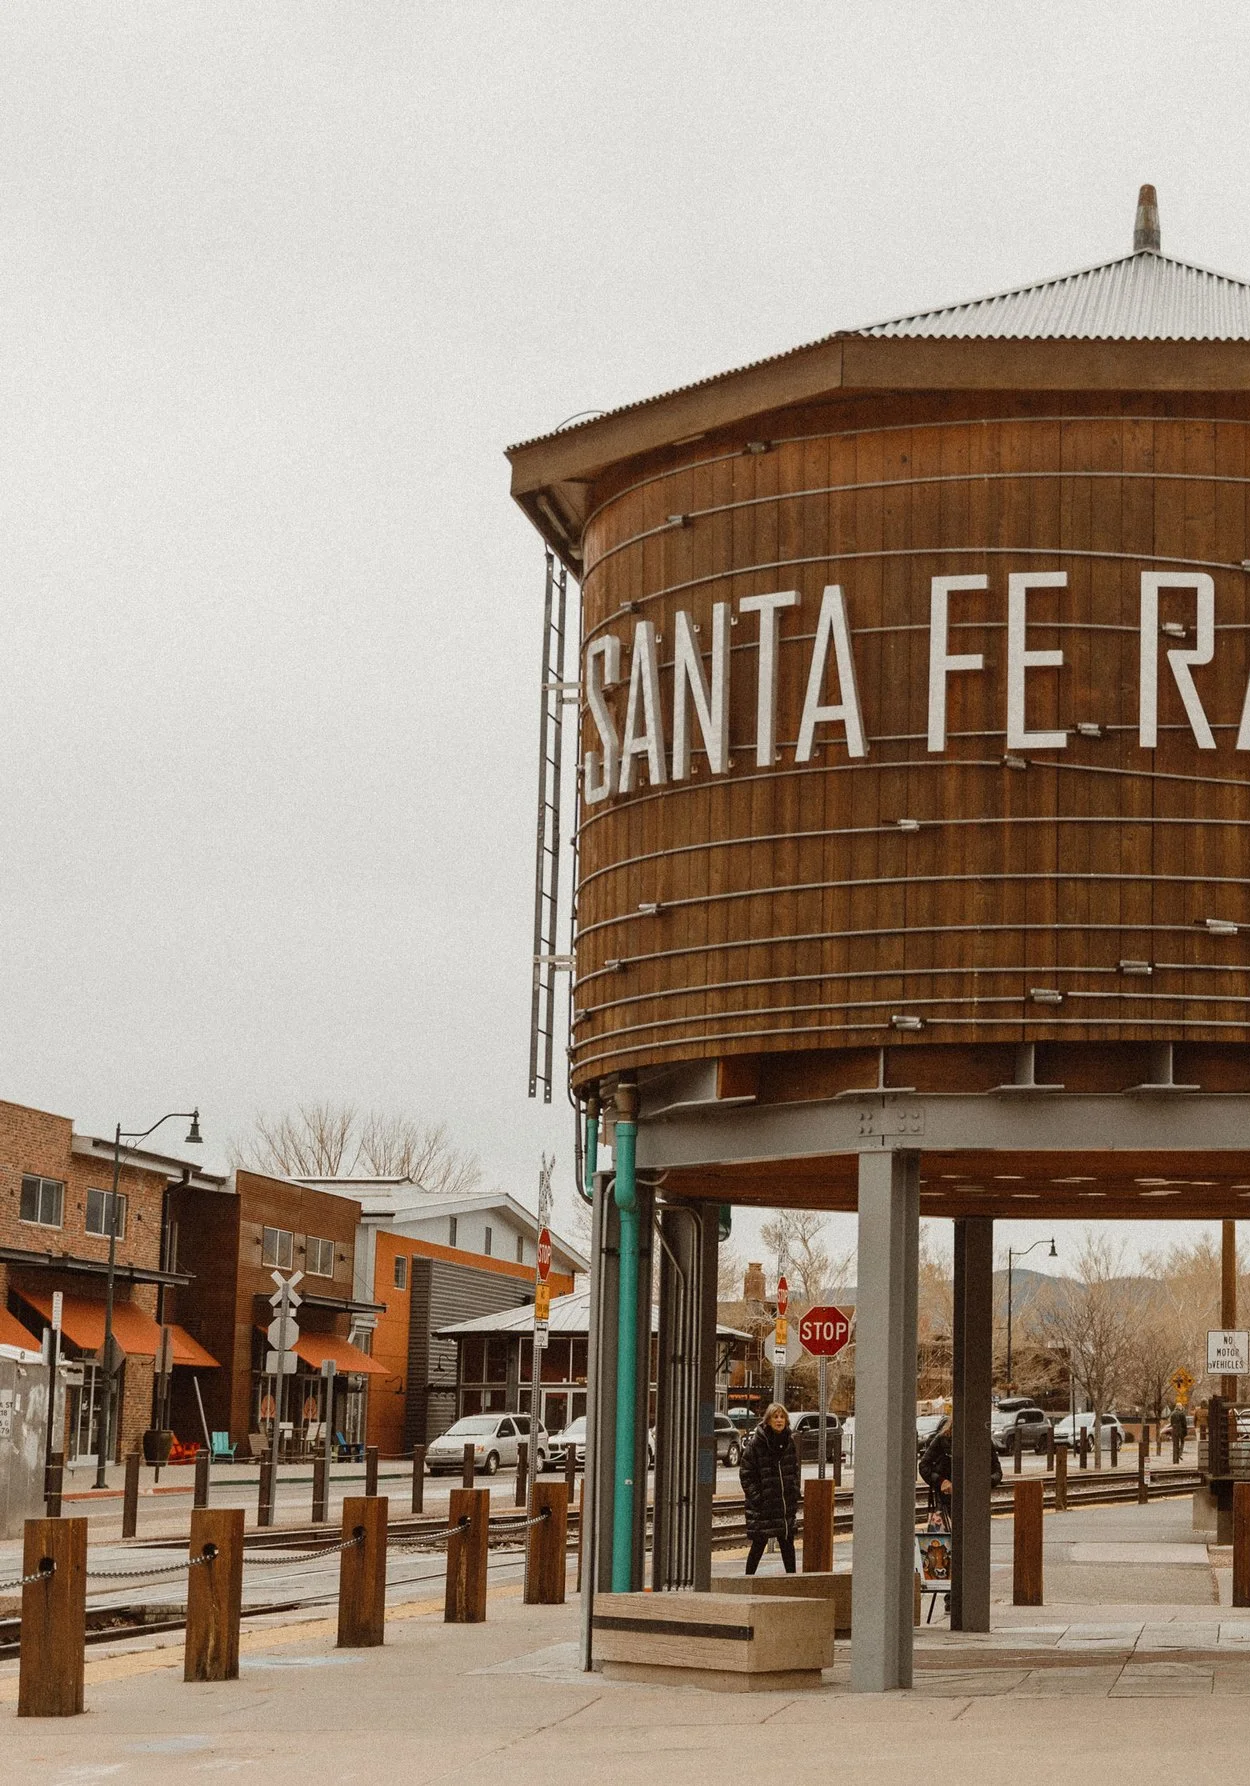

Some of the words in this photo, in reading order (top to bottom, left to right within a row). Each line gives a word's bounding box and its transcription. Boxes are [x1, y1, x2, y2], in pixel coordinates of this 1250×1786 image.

[584, 585, 868, 805] SANTA
[928, 571, 1068, 752] FE
[801, 1321, 847, 1341] STOP
[1223, 1336, 1233, 1345] NO
[1216, 1348, 1240, 1357] MOTOR
[1212, 1360, 1244, 1369] VEHICLES
